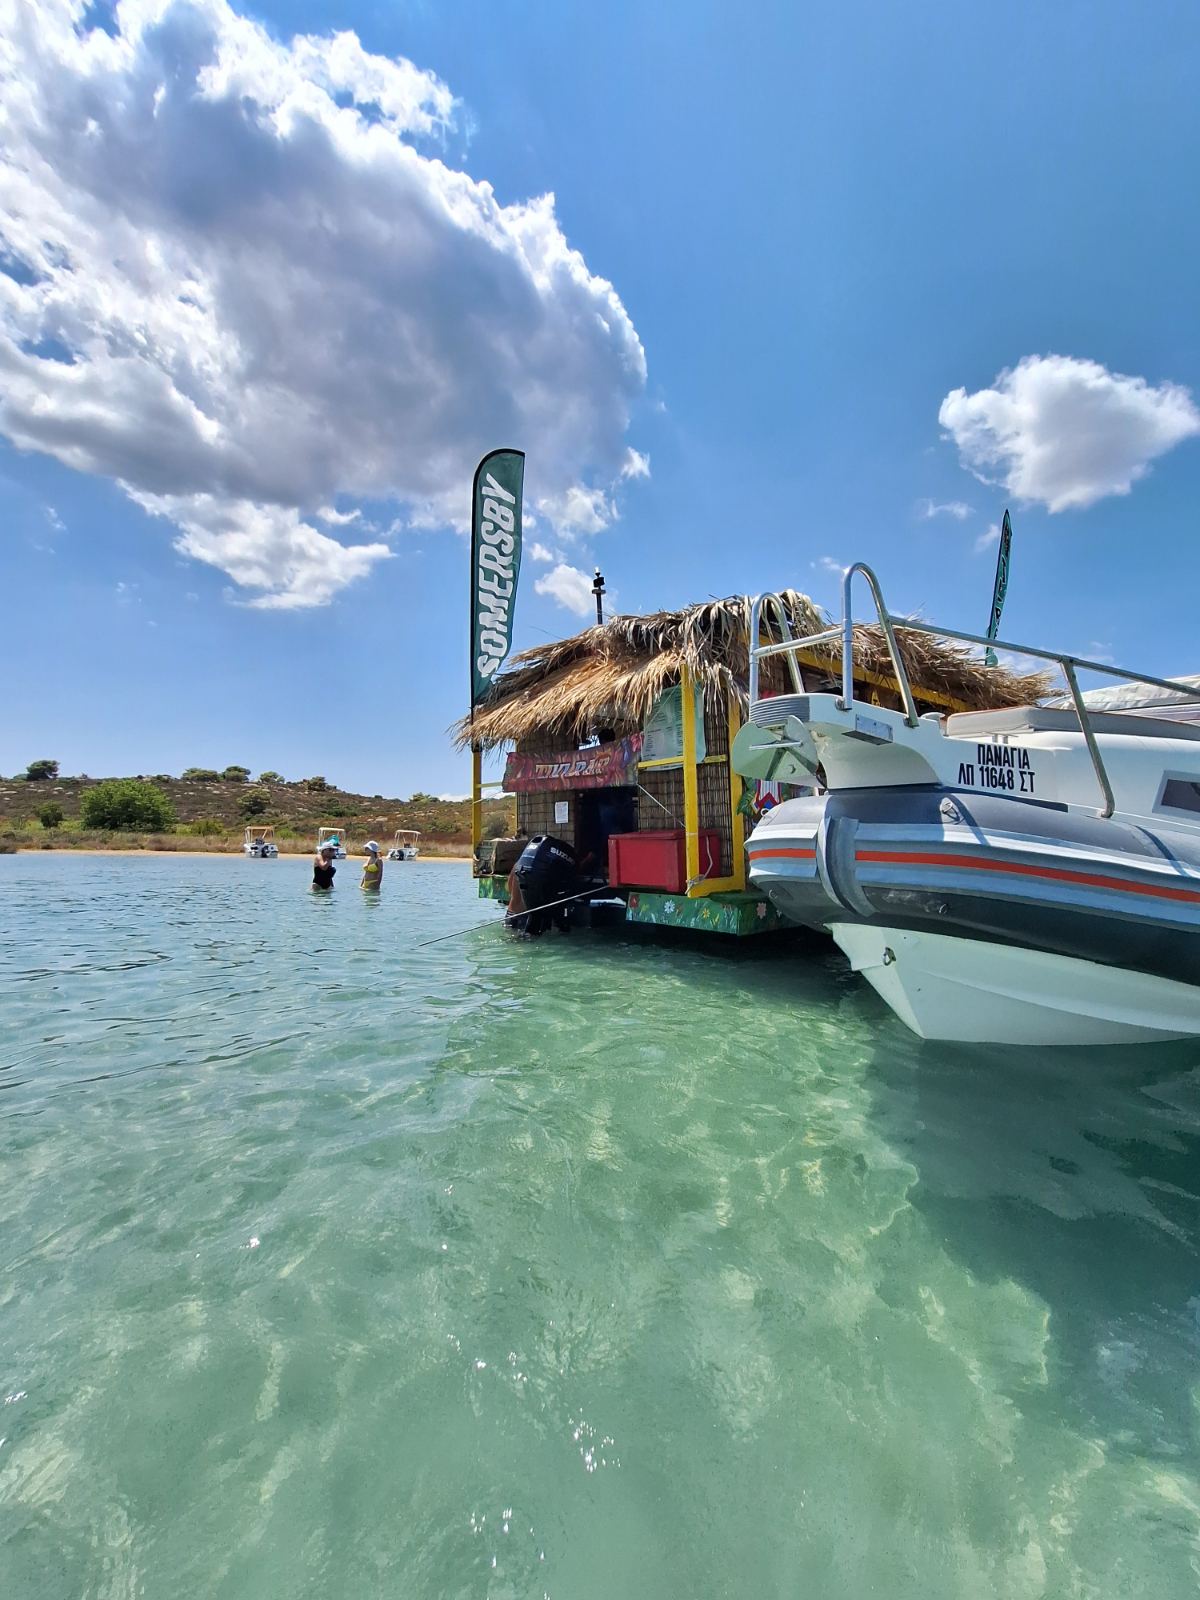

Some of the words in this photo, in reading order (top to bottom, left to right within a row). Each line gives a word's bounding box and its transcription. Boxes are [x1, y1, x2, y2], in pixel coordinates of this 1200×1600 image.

[477, 472, 516, 678] SOMERSBY
[978, 744, 1030, 769] ΠΑΝΑΓΙΑ
[959, 763, 975, 785] ΛΠ
[979, 766, 1014, 789] 11648
[1020, 771, 1035, 792] ΣΤ
